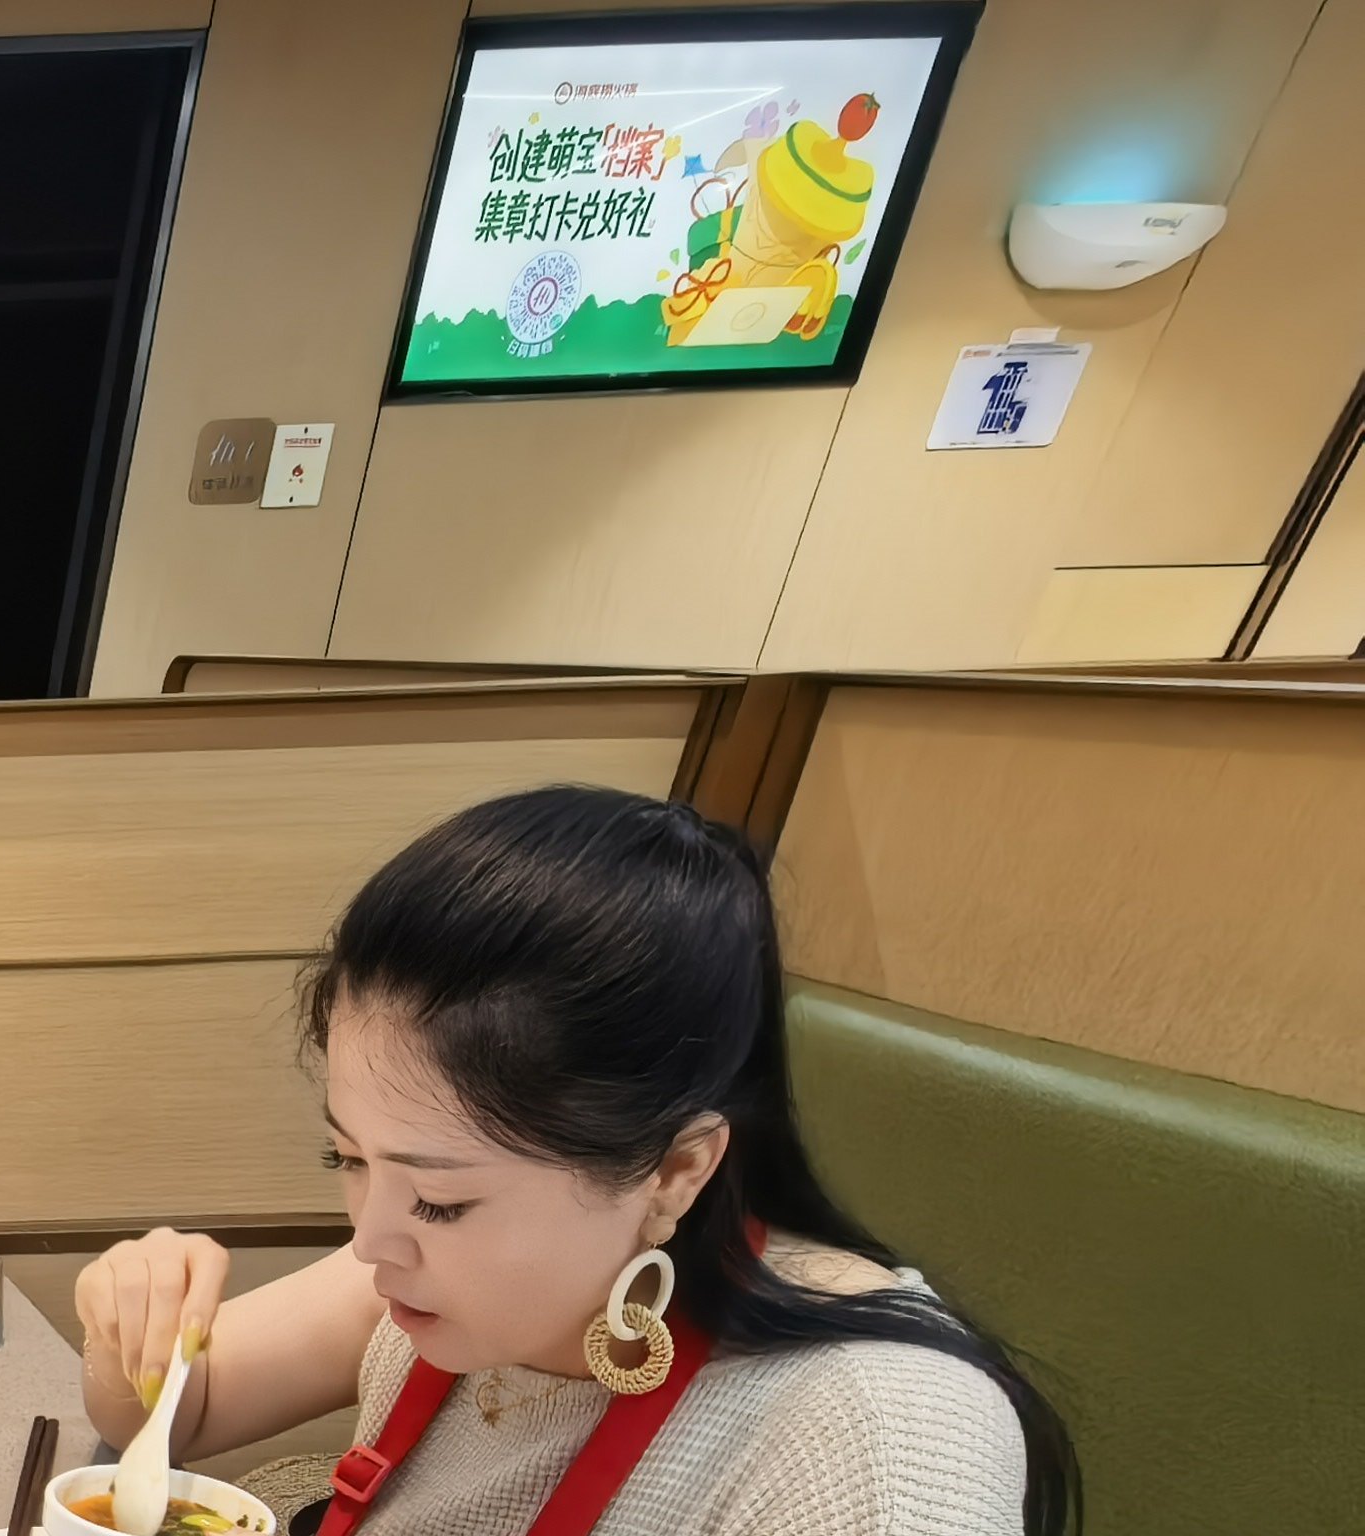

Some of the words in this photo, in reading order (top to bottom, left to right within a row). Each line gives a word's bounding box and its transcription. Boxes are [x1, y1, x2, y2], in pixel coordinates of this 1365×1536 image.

[474, 186, 656, 244] 集章打卡兑好礼
